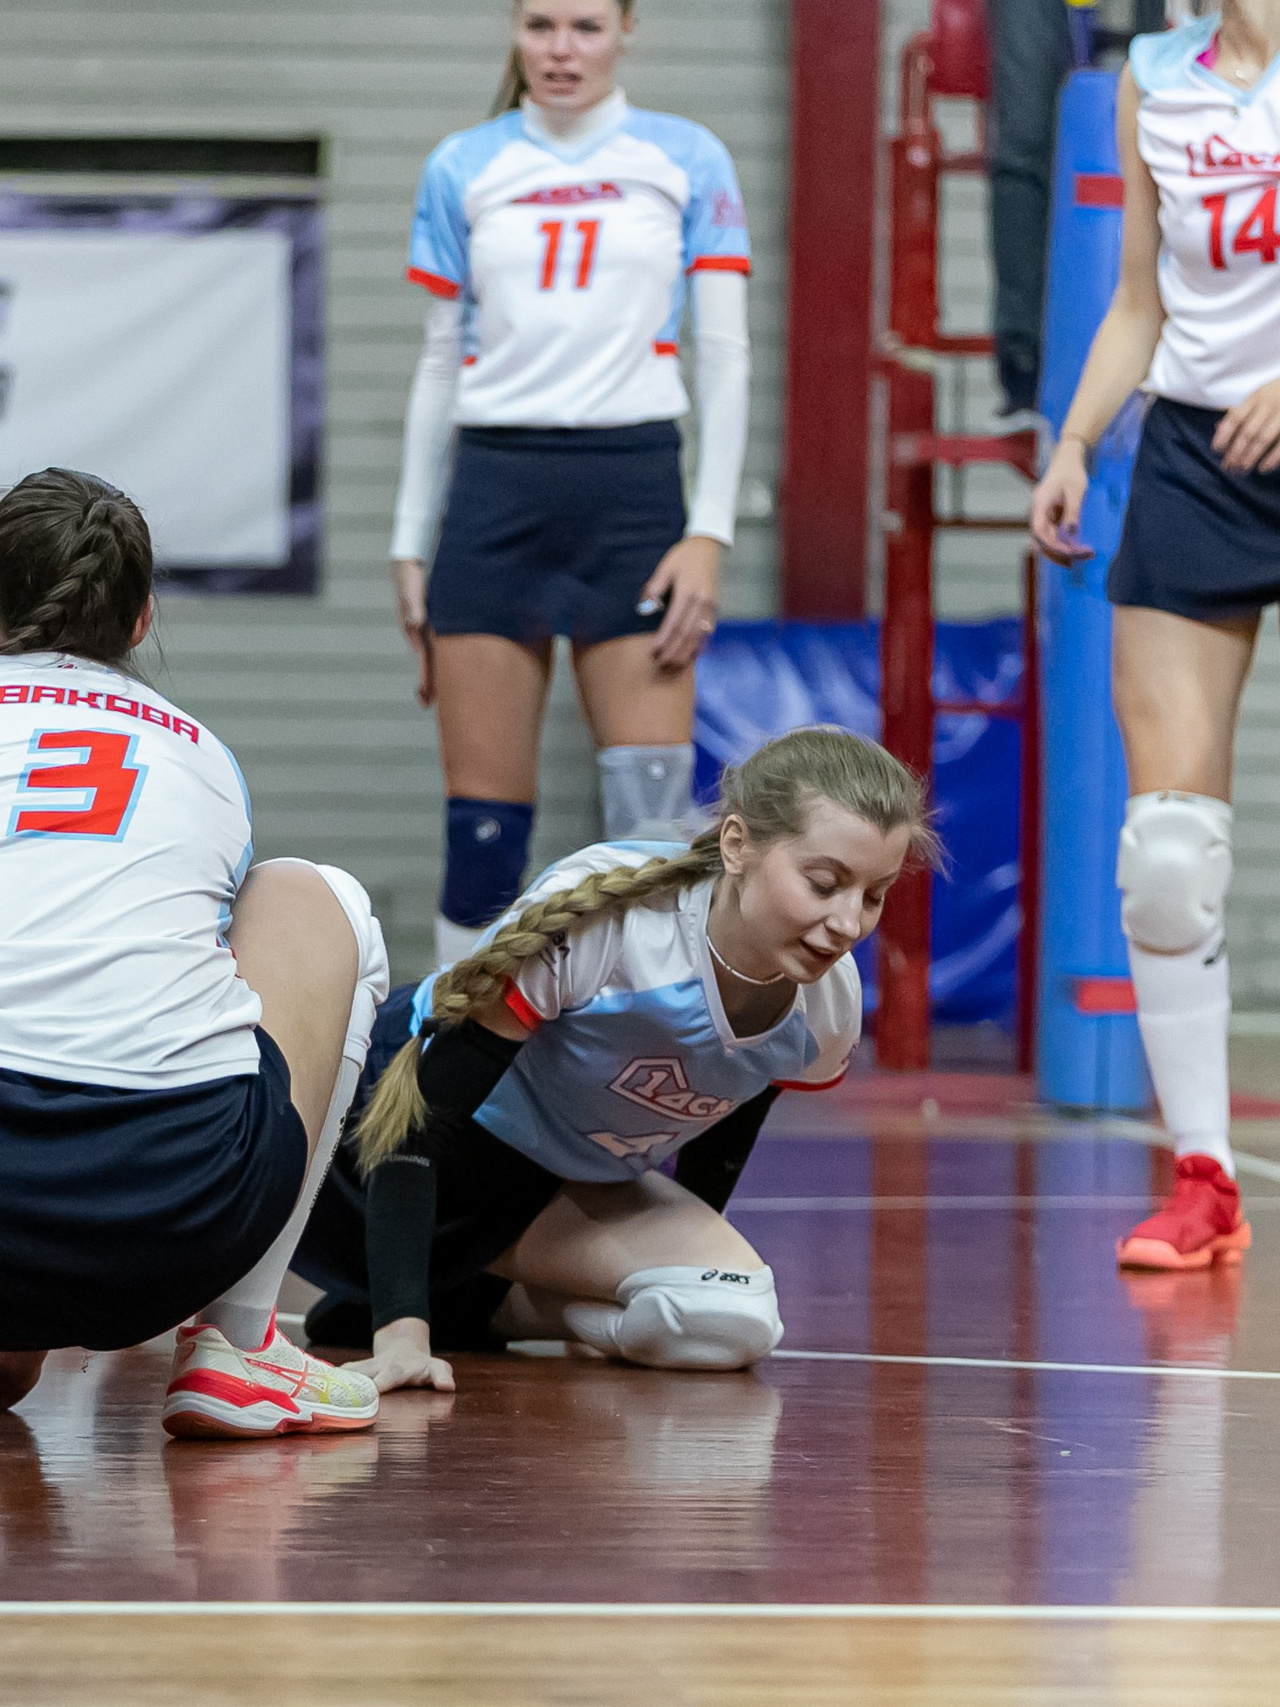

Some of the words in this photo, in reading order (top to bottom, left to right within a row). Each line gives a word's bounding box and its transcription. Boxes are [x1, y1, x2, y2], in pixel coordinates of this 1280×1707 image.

[540, 219, 599, 291] 11
[1201, 186, 1280, 271] 14
[7, 728, 148, 842] 3
